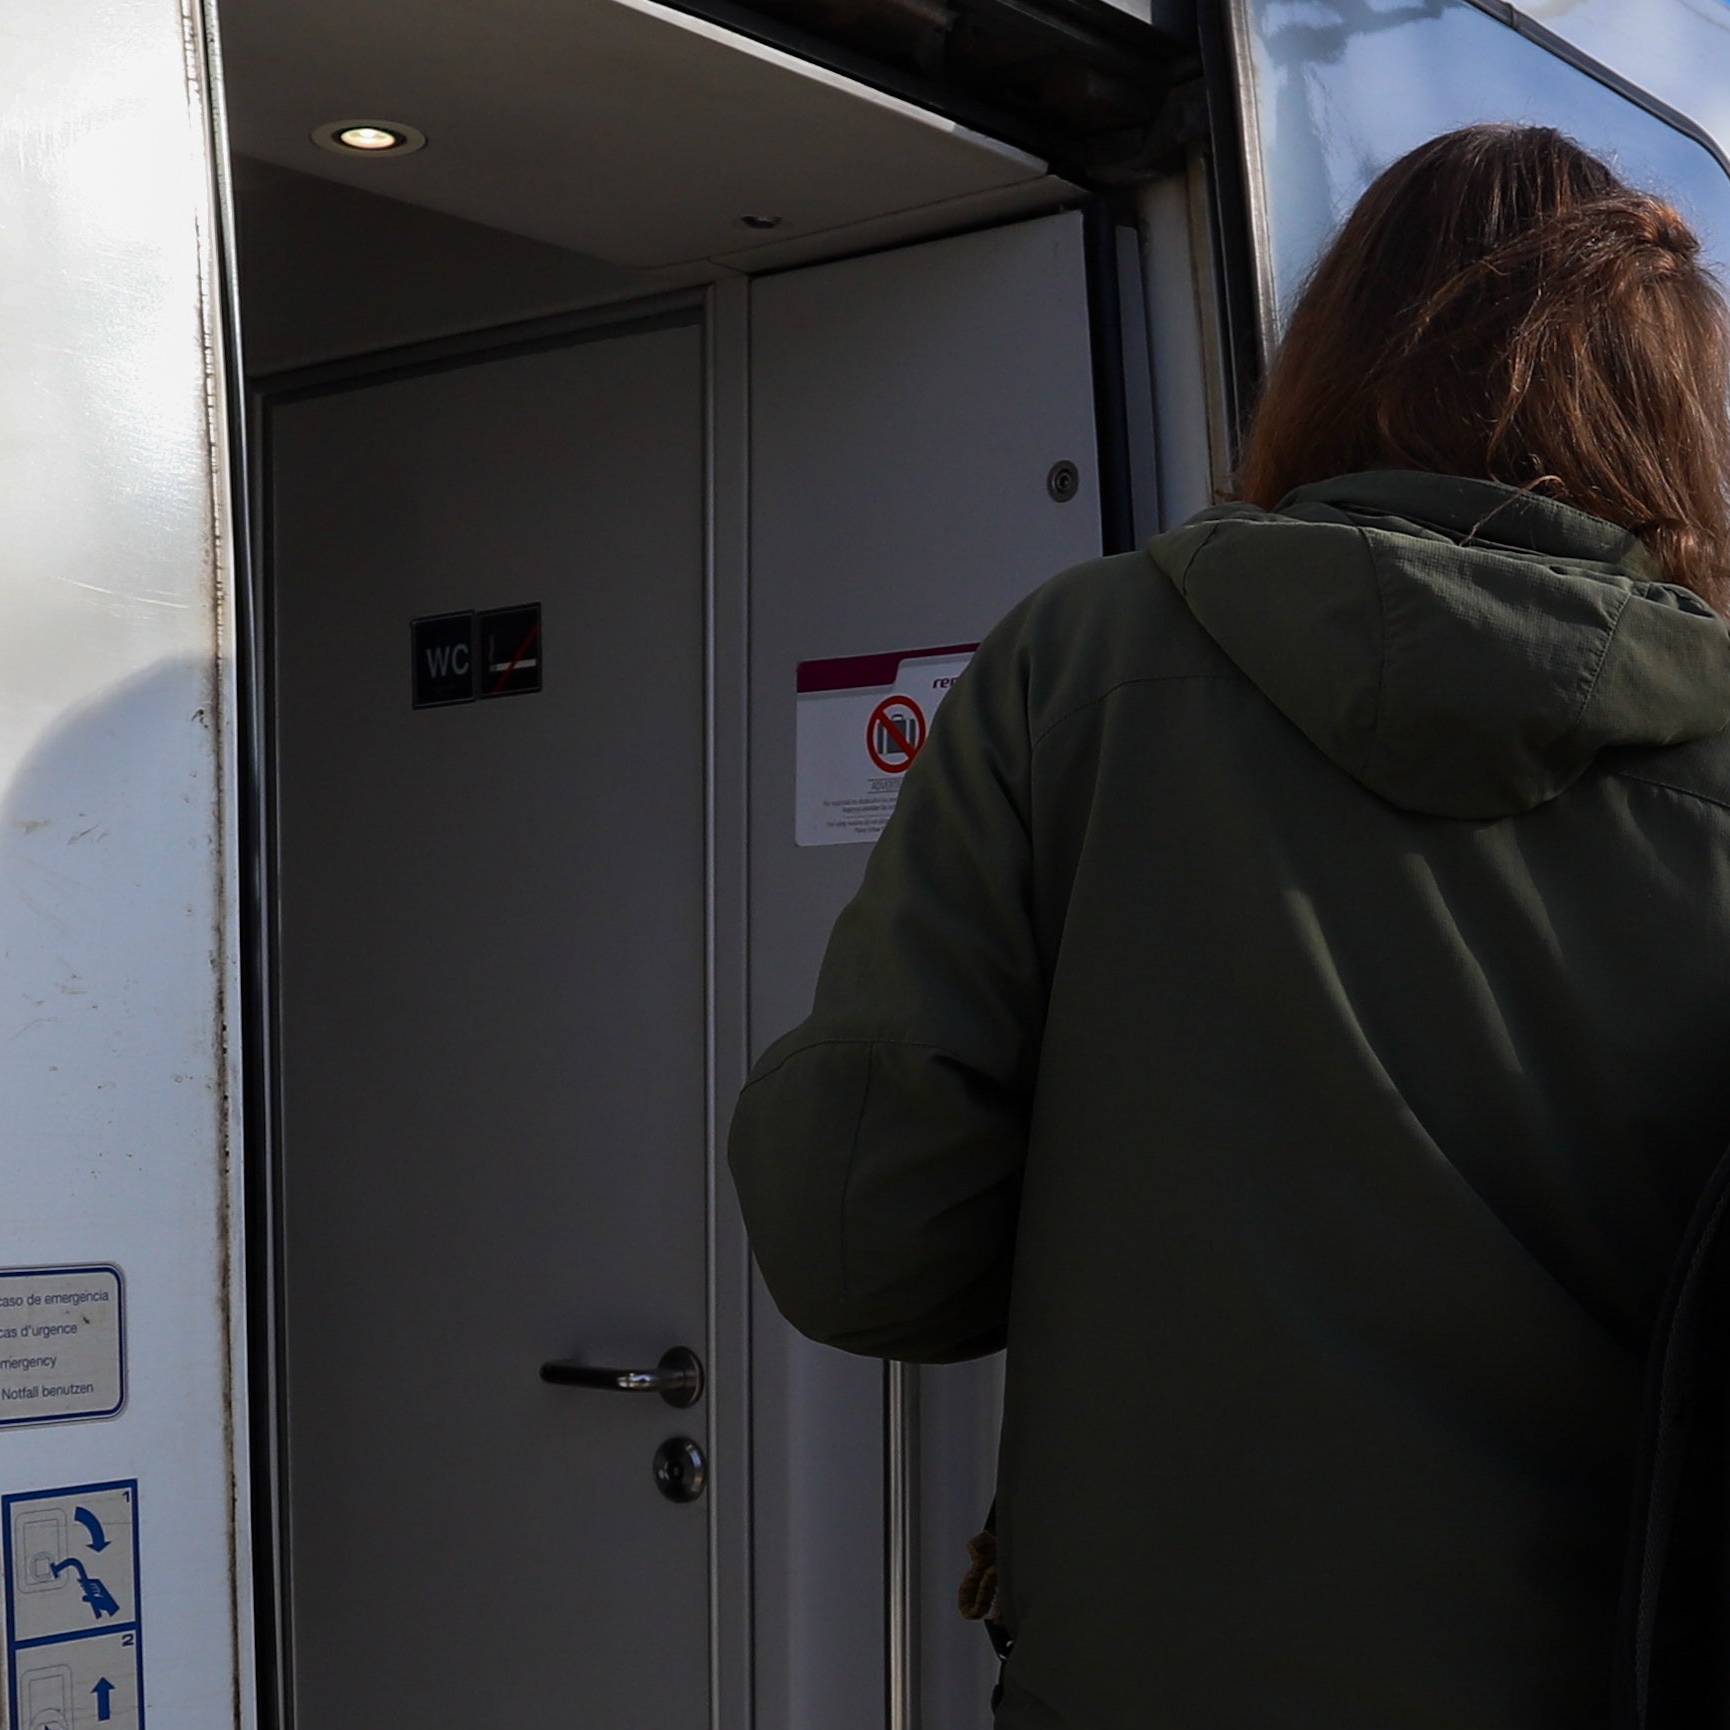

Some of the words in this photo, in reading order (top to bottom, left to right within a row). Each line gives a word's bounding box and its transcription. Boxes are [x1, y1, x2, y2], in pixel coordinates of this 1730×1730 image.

[425, 643, 470, 679] WC
[932, 676, 960, 690] ren
[27, 1293, 41, 1306] de
[44, 1289, 109, 1305] emergencia
[1, 1385, 39, 1401] Notfall
[42, 1382, 94, 1398] benutzen
[121, 1489, 131, 1503] 1
[121, 1633, 135, 1647] 2
